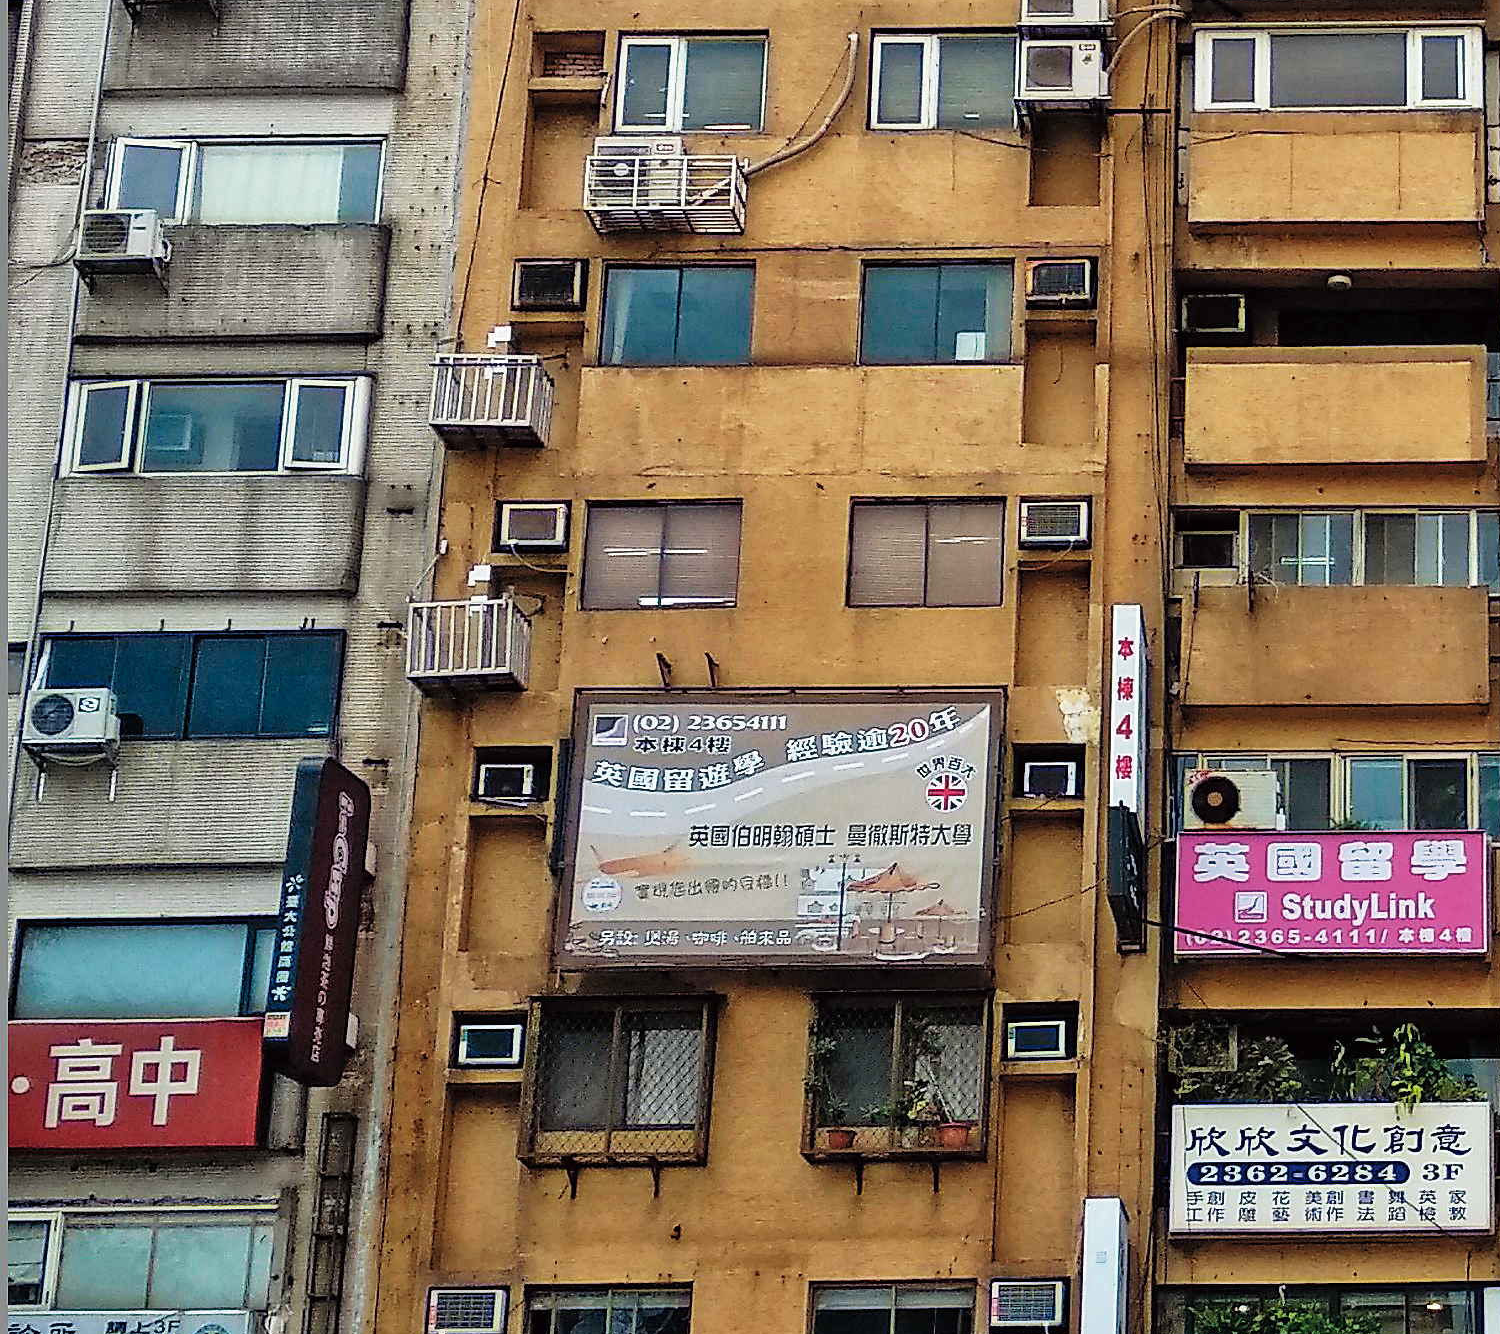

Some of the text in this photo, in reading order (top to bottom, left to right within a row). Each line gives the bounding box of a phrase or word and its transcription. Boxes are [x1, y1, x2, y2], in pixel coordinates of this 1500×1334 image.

[632, 714, 788, 735] (02) 23654111
[592, 705, 962, 794] 英國留遊學 經驗逾20年
[633, 736, 732, 755] 本棟4樓
[914, 755, 978, 779] 世界百大
[689, 824, 973, 849] 英國伯明翰碩士 曼徹斯特大學
[1192, 839, 1468, 883] 英國留學
[1281, 892, 1437, 925] StudyLink
[44, 1035, 202, 1130] 高中
[1184, 1123, 1472, 1157] 欣欣文化創意
[1200, 1163, 1464, 1183] 2362-6284 3F
